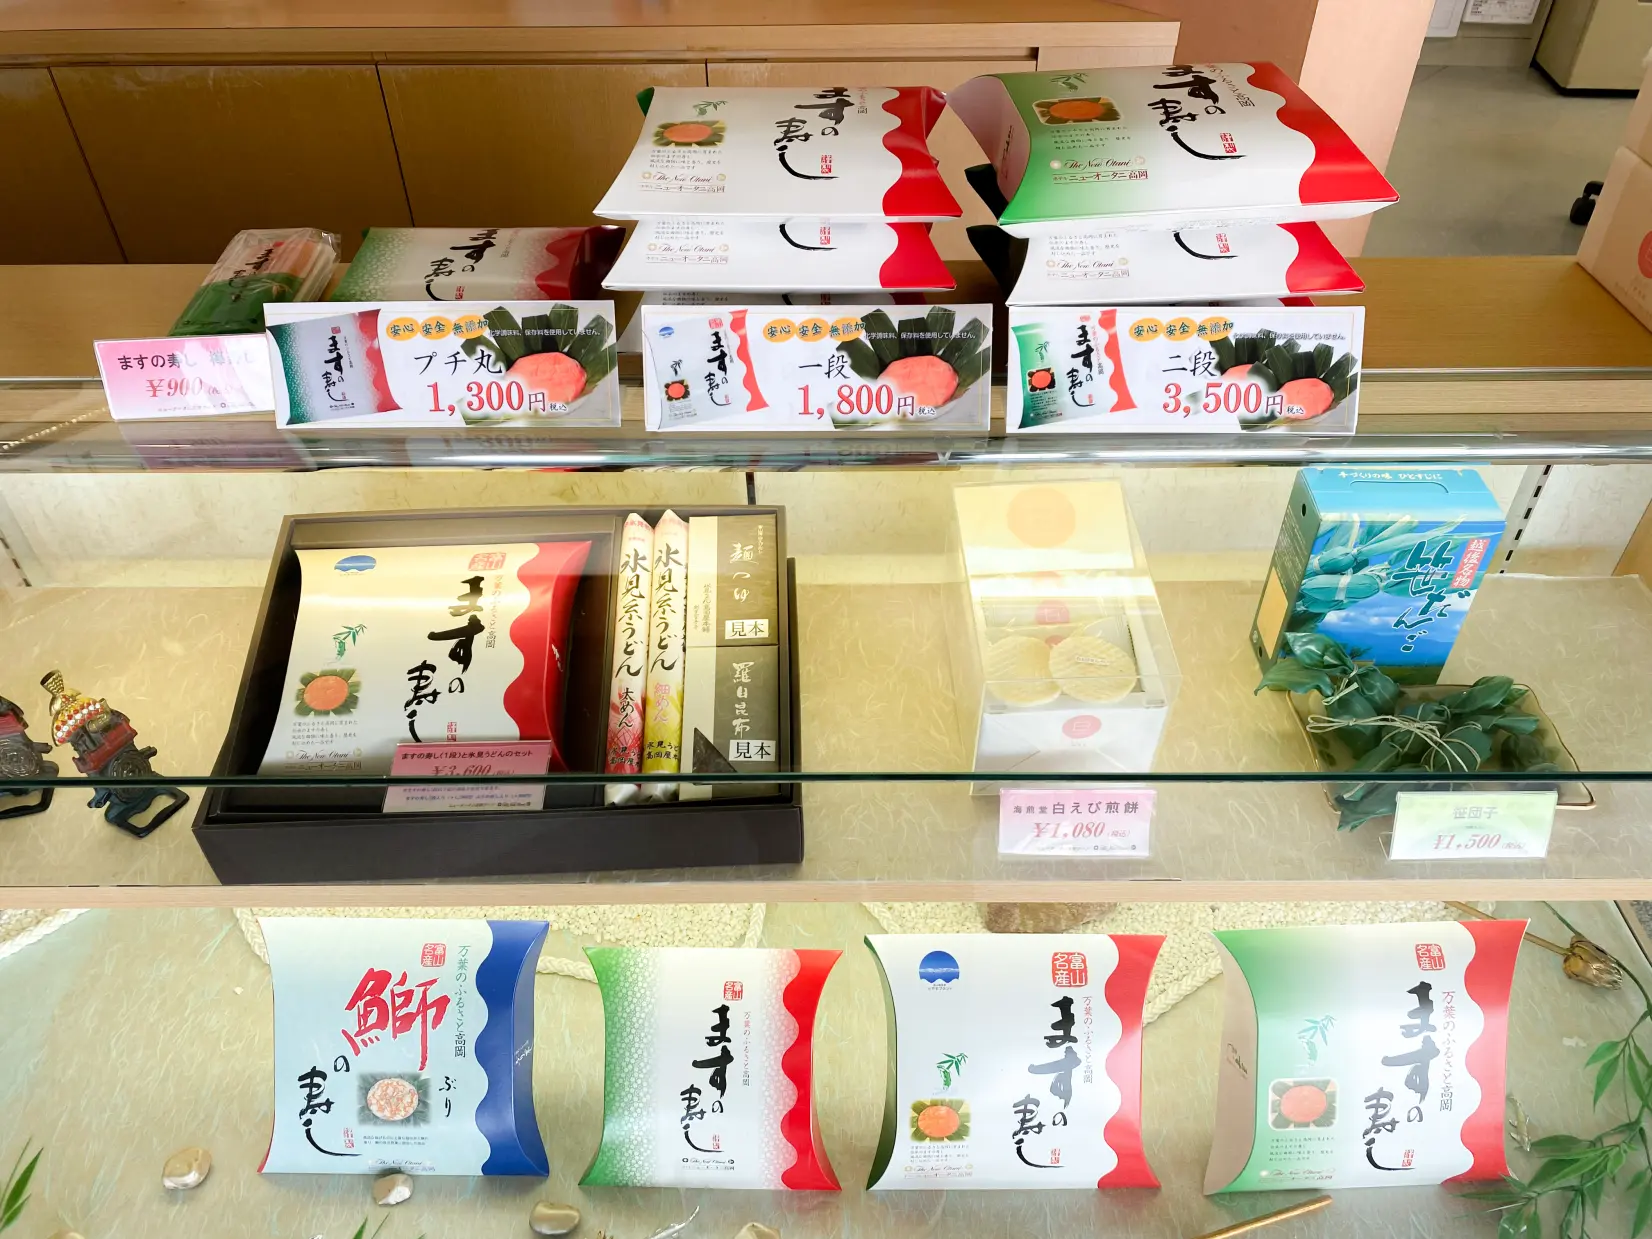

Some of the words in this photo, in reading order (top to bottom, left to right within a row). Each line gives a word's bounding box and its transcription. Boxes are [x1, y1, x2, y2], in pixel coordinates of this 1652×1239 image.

[1064, 159, 1083, 169] The
[1105, 159, 1131, 168] Otani
[390, 323, 414, 336] 安心
[422, 321, 446, 333] 安全
[453, 318, 489, 334] 無添加
[767, 325, 791, 337] 安心
[799, 323, 823, 336] 安全
[829, 322, 866, 337] 無添加
[1134, 324, 1158, 336] 安心
[1166, 321, 1190, 335] 安全
[1196, 321, 1234, 337] 無添加
[413, 349, 503, 375] プチ丸
[798, 354, 851, 380] 一段
[1162, 350, 1218, 377] 二段
[550, 402, 567, 412] 税込
[918, 407, 936, 415] 税込
[1286, 406, 1304, 415] 税込
[1453, 540, 1486, 587] 越後名物
[731, 621, 765, 637] 見本
[618, 687, 635, 728] 太めん
[654, 683, 670, 722] 細めん
[734, 742, 772, 759] 見本
[1052, 801, 1139, 815] 白えび煎餅
[1453, 806, 1498, 819] 笹団子
[421, 943, 447, 967] 富山名産
[1415, 944, 1446, 971] 富山名産
[1052, 952, 1088, 987] 富山名産
[455, 945, 471, 1058] 万葉のふるさと高岡
[439, 1076, 456, 1118] ぶり
